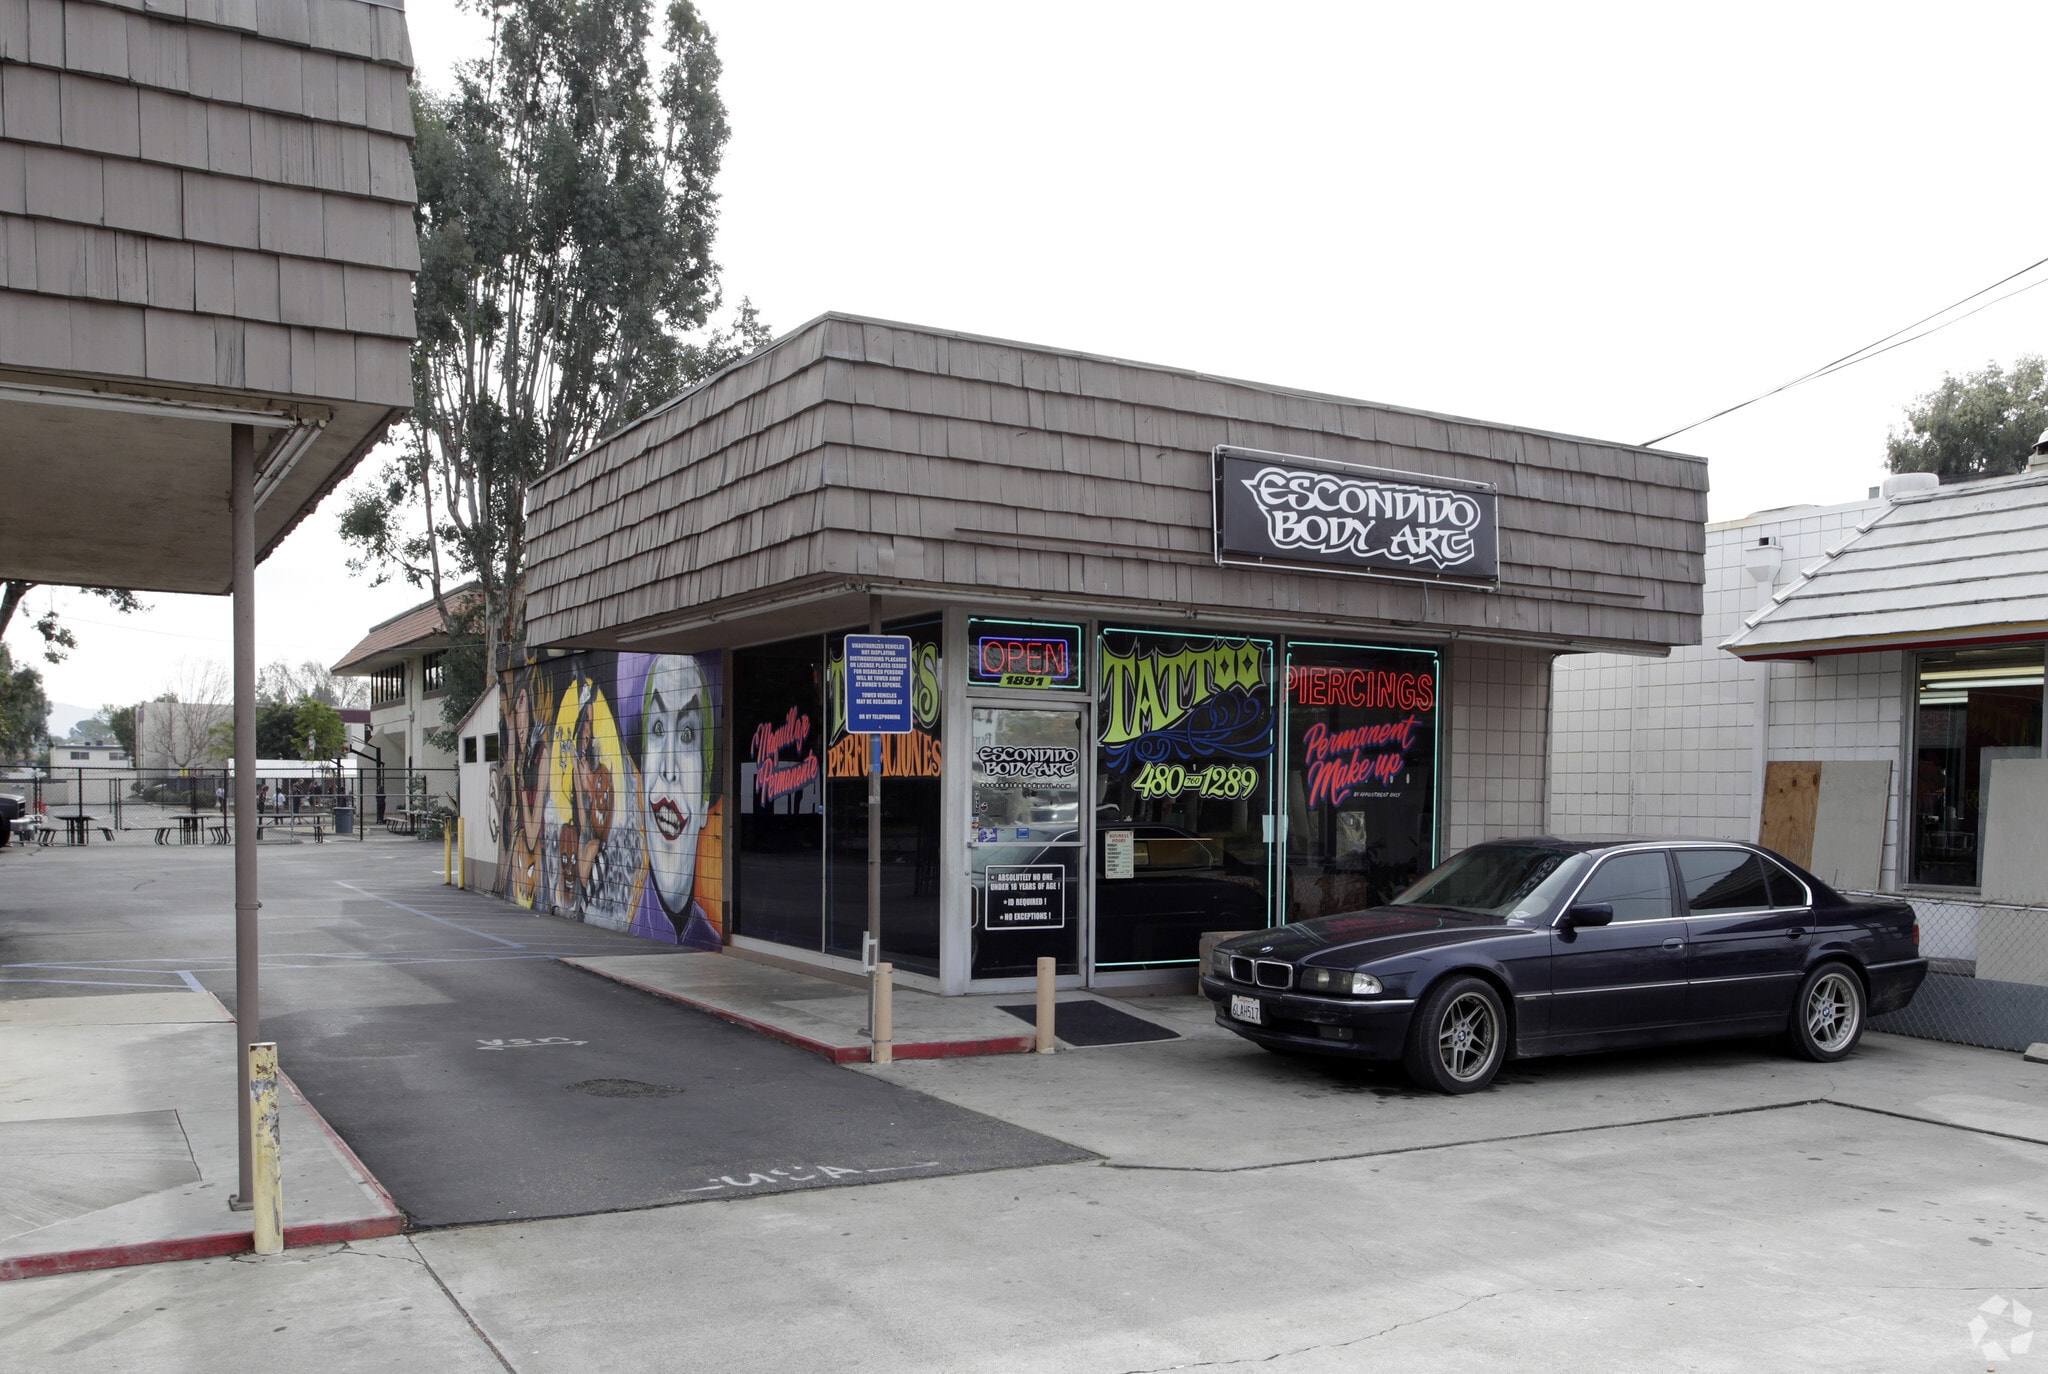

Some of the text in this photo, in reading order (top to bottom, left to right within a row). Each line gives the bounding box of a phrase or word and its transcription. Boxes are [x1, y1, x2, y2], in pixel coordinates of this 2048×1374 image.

[1257, 474, 1476, 527] ESCONDIDO
[1272, 510, 1475, 560] BODY ART
[983, 641, 1064, 673] OPEN
[1006, 676, 1045, 686] 1891
[1101, 638, 1263, 744] TATTOO
[1284, 665, 1434, 711] PIERCINGS
[827, 728, 942, 777] PERFOACIONES
[978, 746, 1079, 763] ESCONDIDO
[1303, 714, 1422, 764] Permanent
[756, 748, 818, 806] Permanente
[984, 761, 1075, 777] BODY ART
[1186, 776, 1200, 785] 760
[1308, 748, 1404, 809] Make up
[998, 873, 1032, 881] ABSOLUTELY
